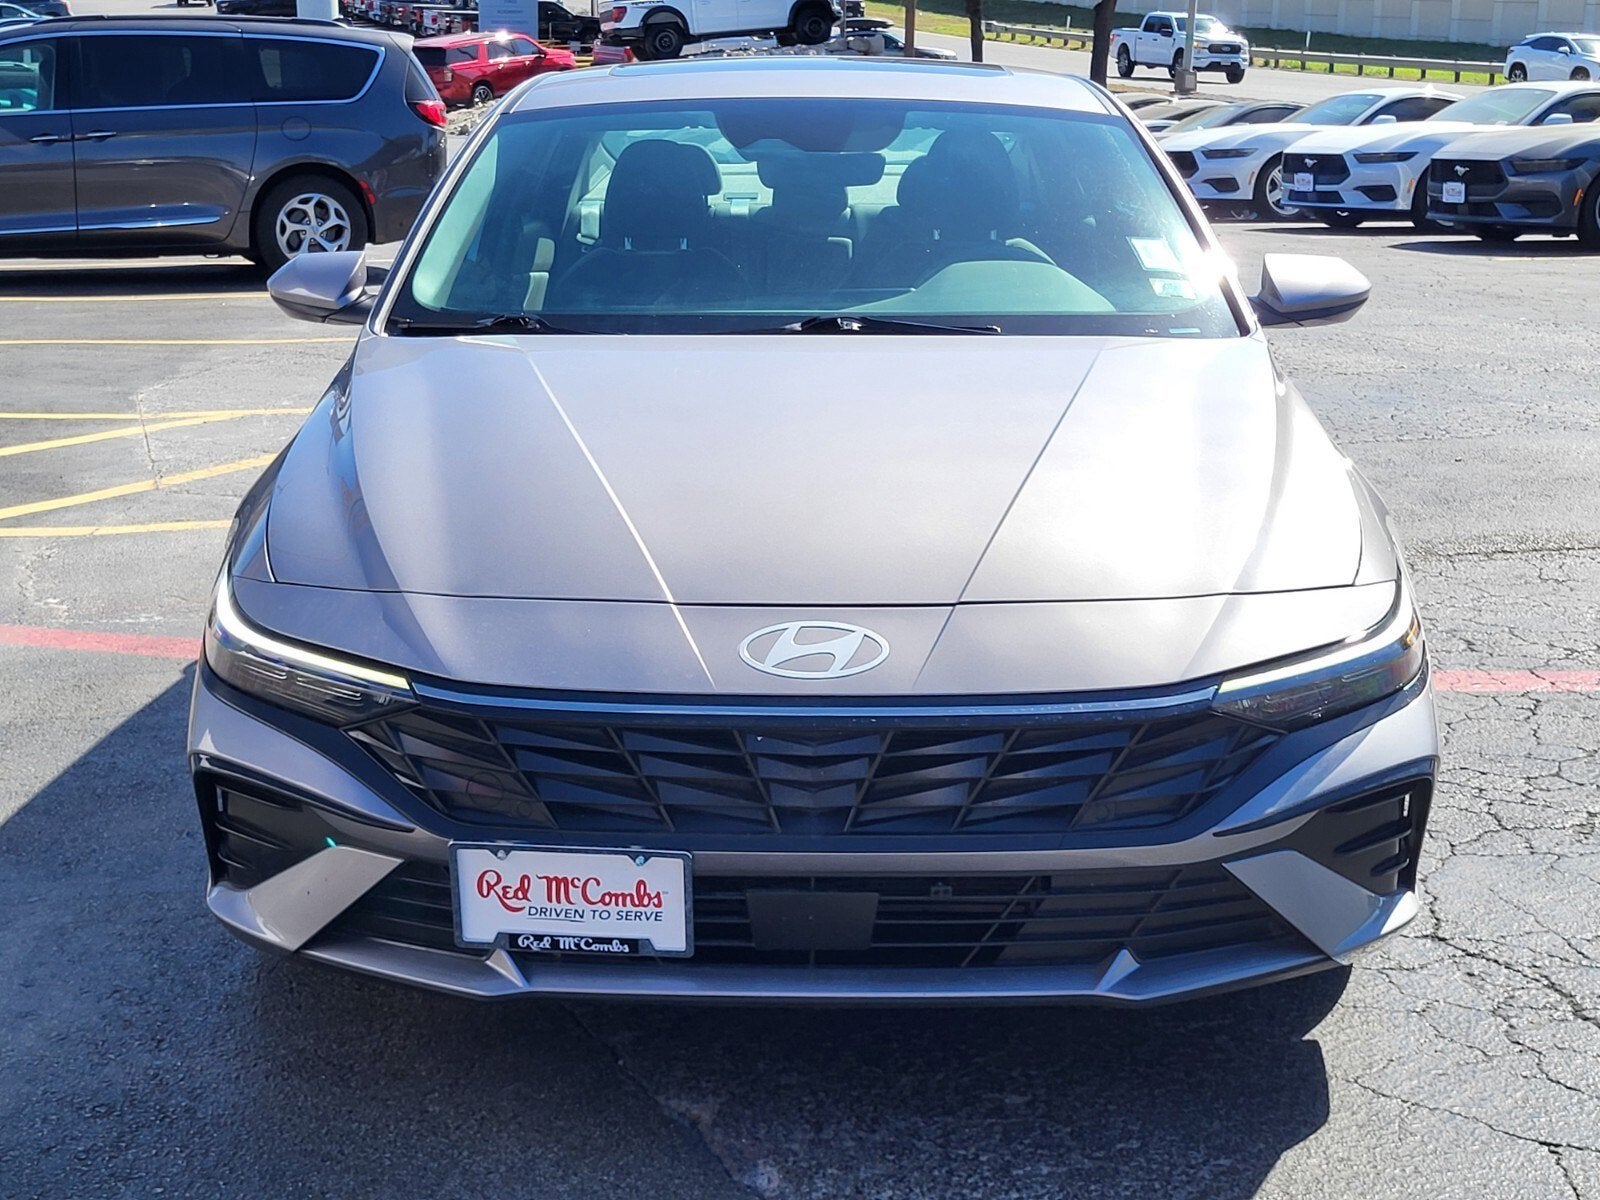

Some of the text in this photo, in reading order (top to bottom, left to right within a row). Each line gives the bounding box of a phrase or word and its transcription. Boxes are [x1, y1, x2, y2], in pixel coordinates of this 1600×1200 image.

[476, 869, 663, 913] Red McCombs
[528, 906, 663, 922] DRIVEN TO SERVE
[518, 934, 630, 953] Red McCombs
